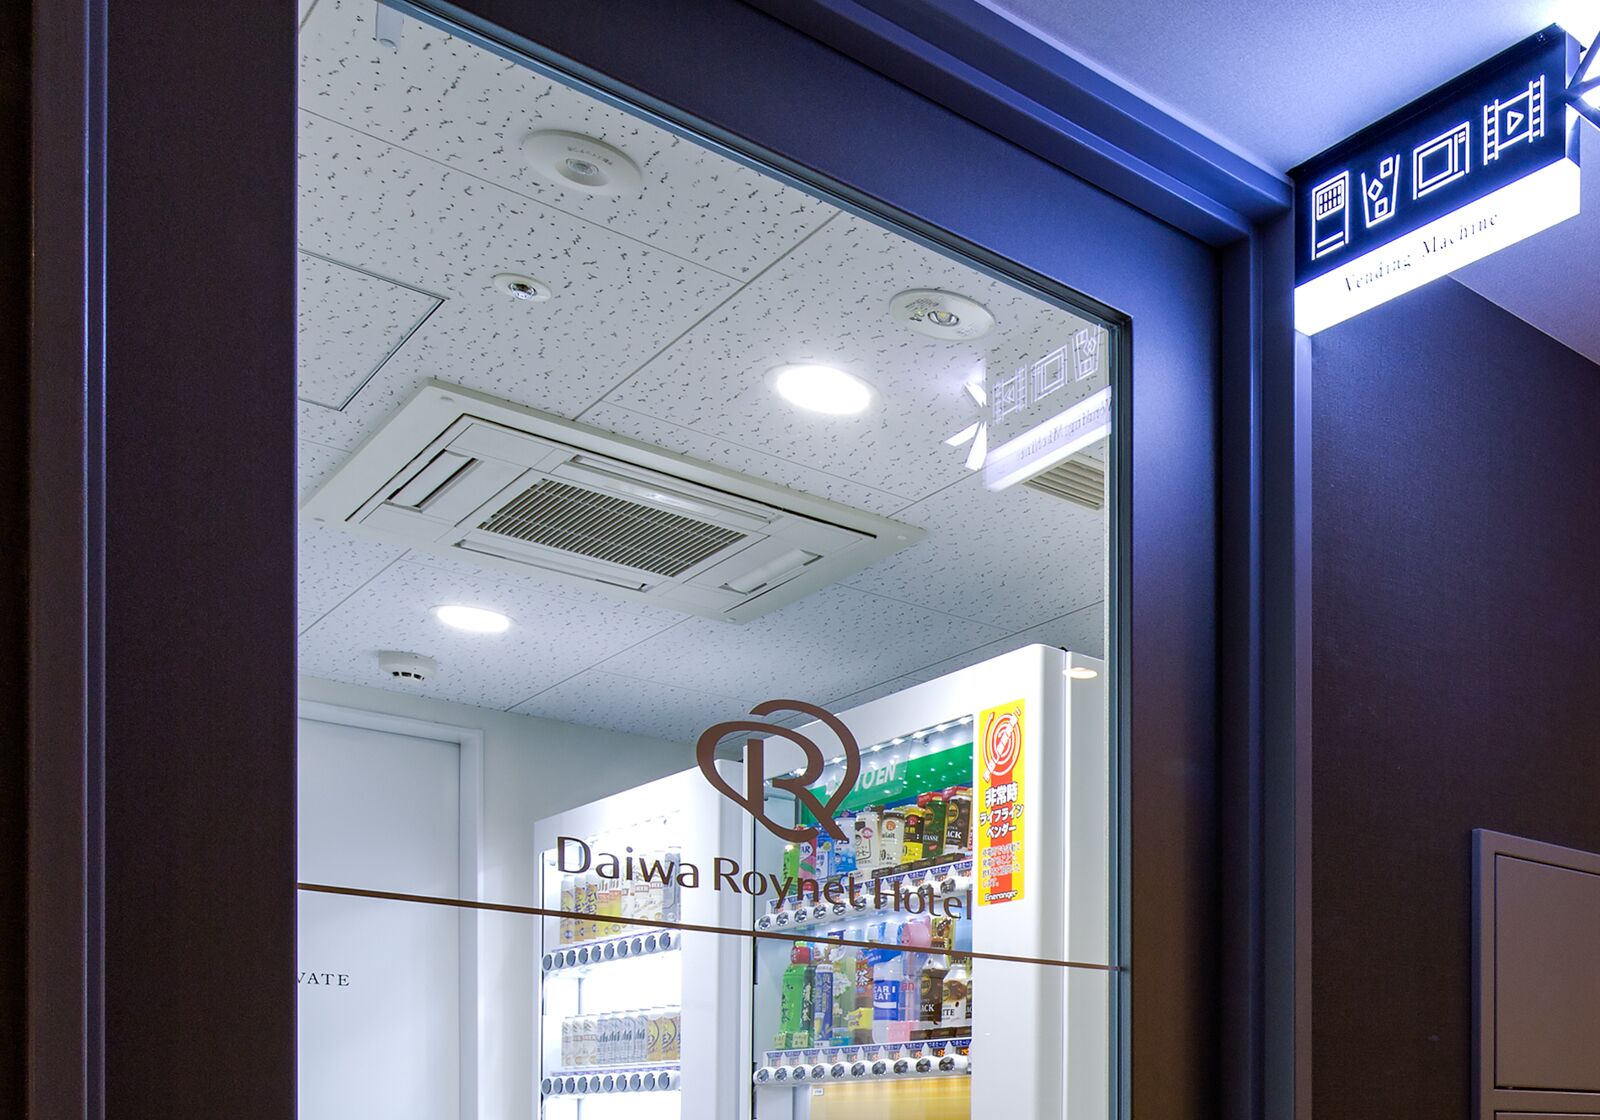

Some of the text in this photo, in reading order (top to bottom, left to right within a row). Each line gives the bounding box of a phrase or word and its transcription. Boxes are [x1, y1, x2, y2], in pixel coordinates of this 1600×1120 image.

[1343, 213, 1498, 294] Vending Machine
[985, 782, 1018, 808] 非常時
[980, 804, 1024, 826] ライフライン
[986, 823, 1016, 840] ベンダー
[557, 836, 973, 920] Daiwa Roynet Hotel
